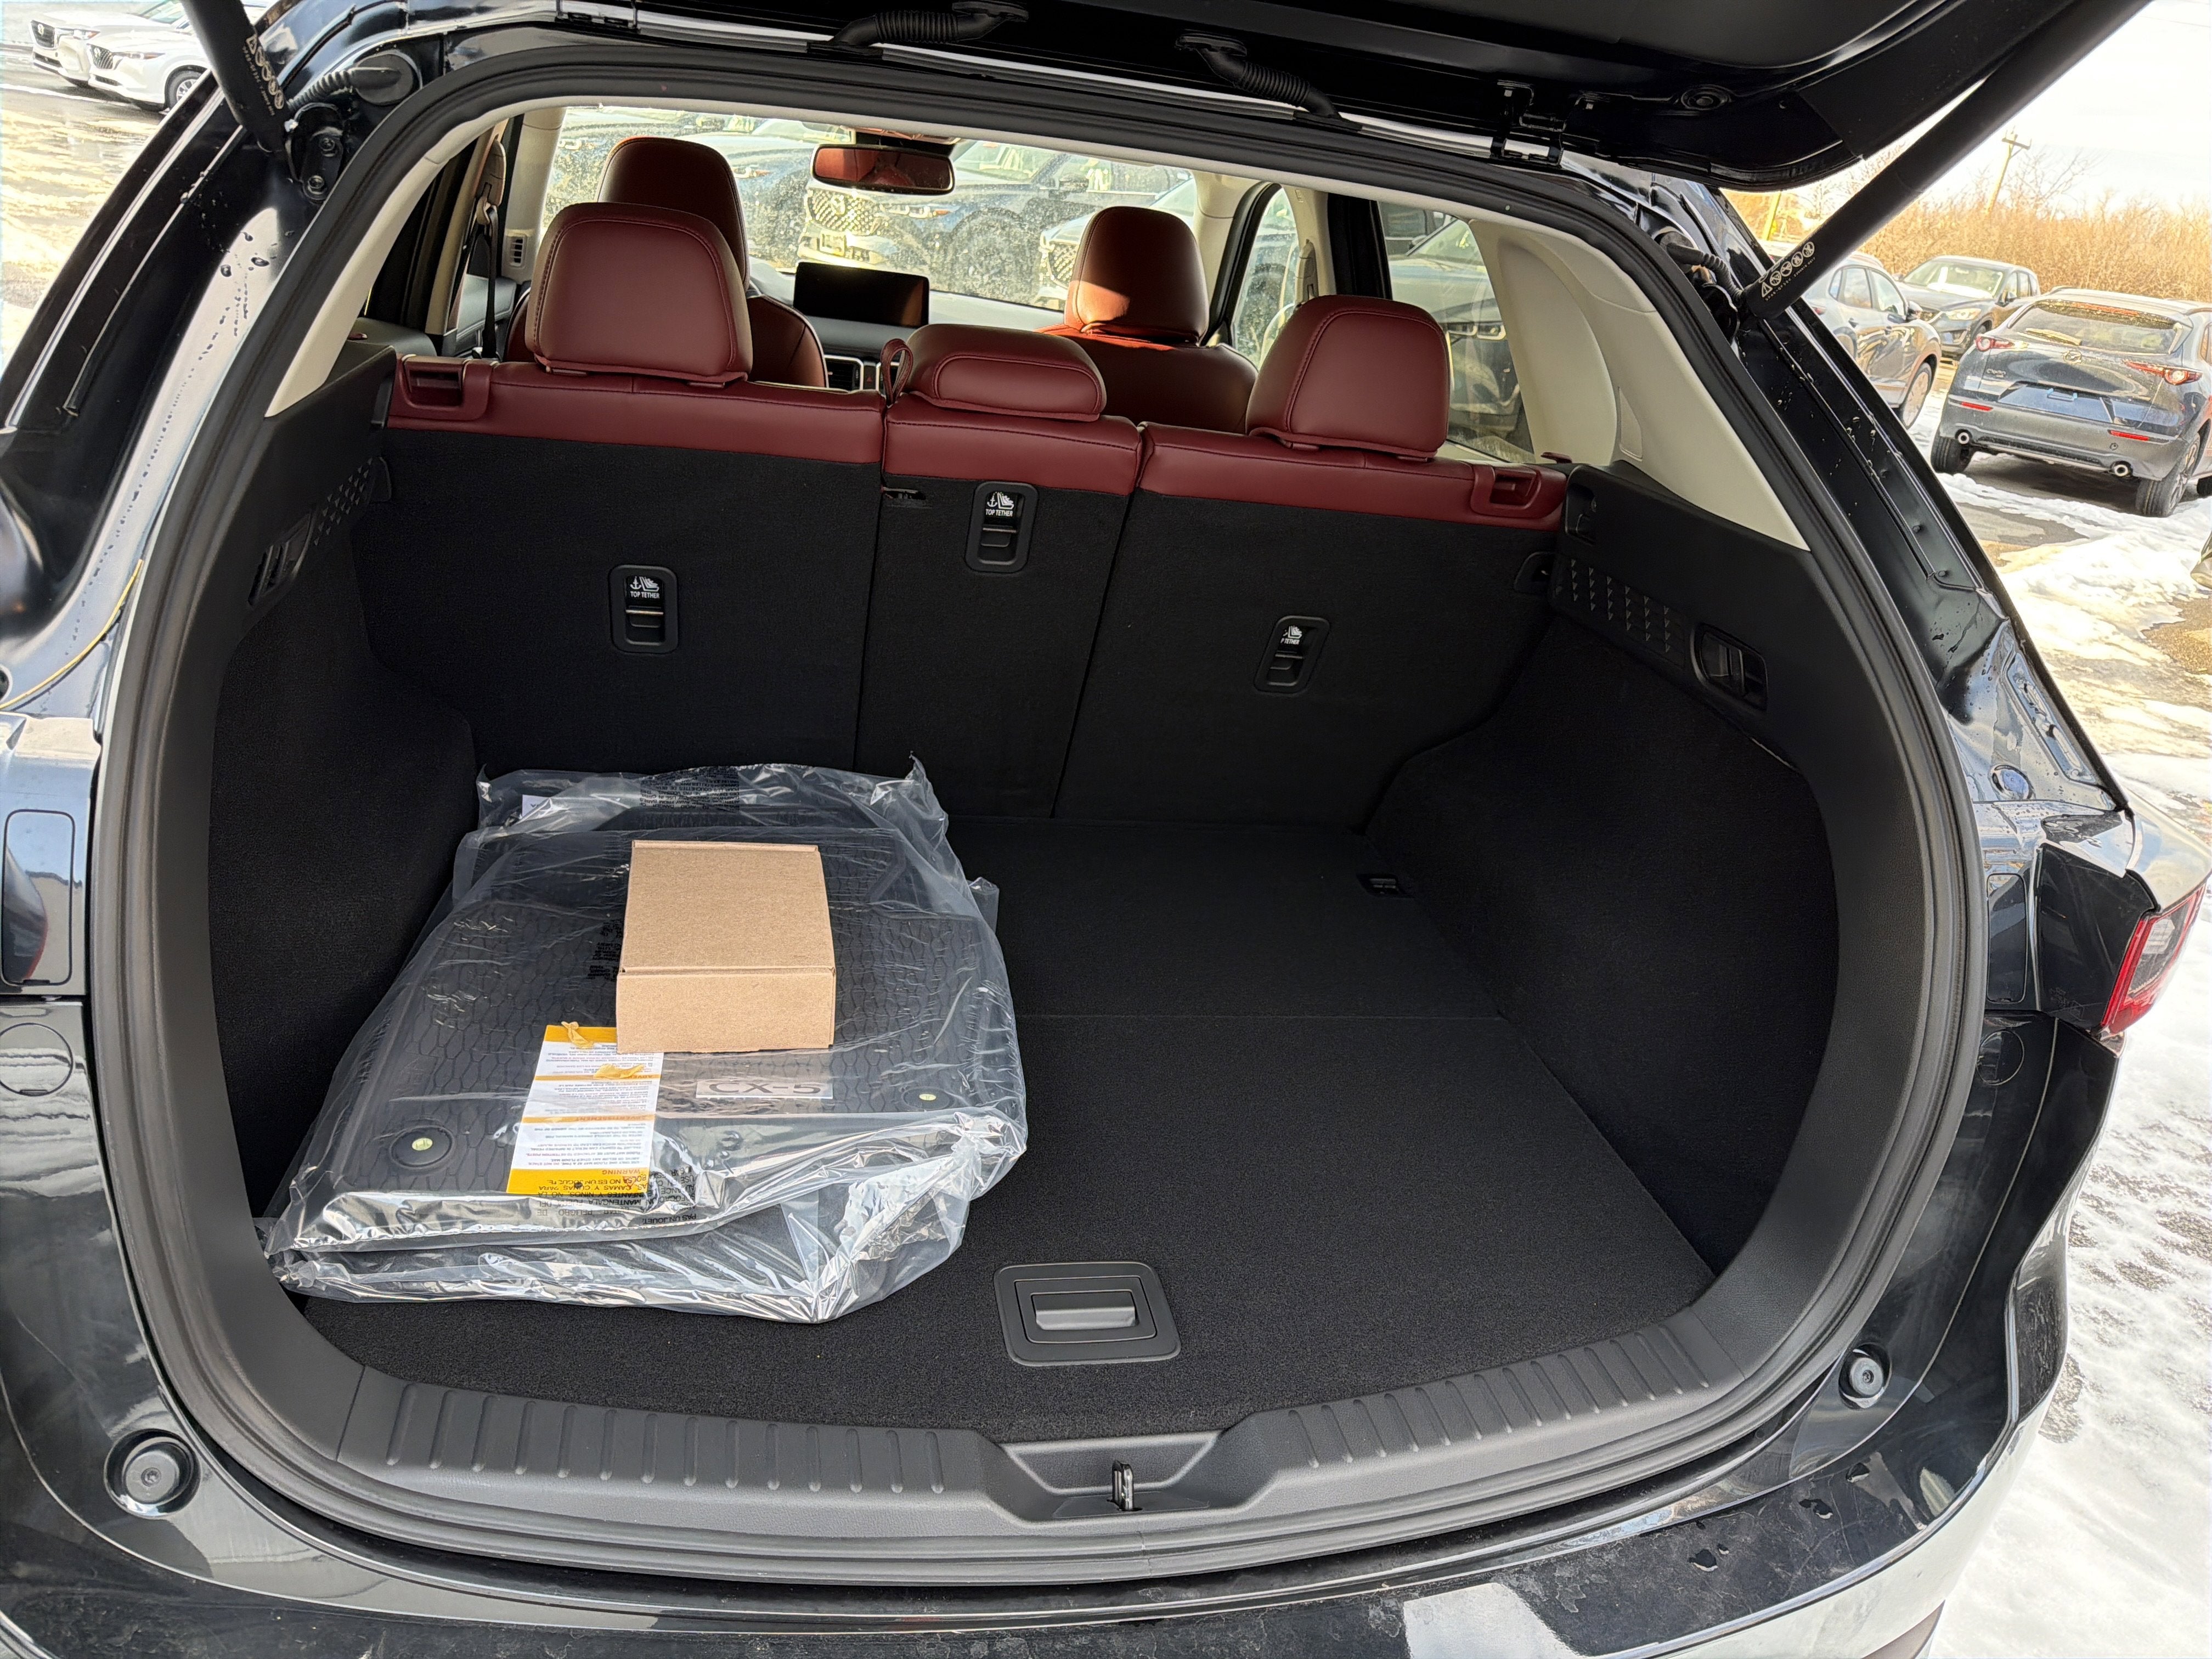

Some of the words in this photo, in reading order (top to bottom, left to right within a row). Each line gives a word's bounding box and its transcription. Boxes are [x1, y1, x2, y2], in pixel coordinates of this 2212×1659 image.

[709, 1082, 821, 1094] CX-5
[681, 1175, 695, 1183] USE
[661, 1184, 695, 1194] ALANCE
